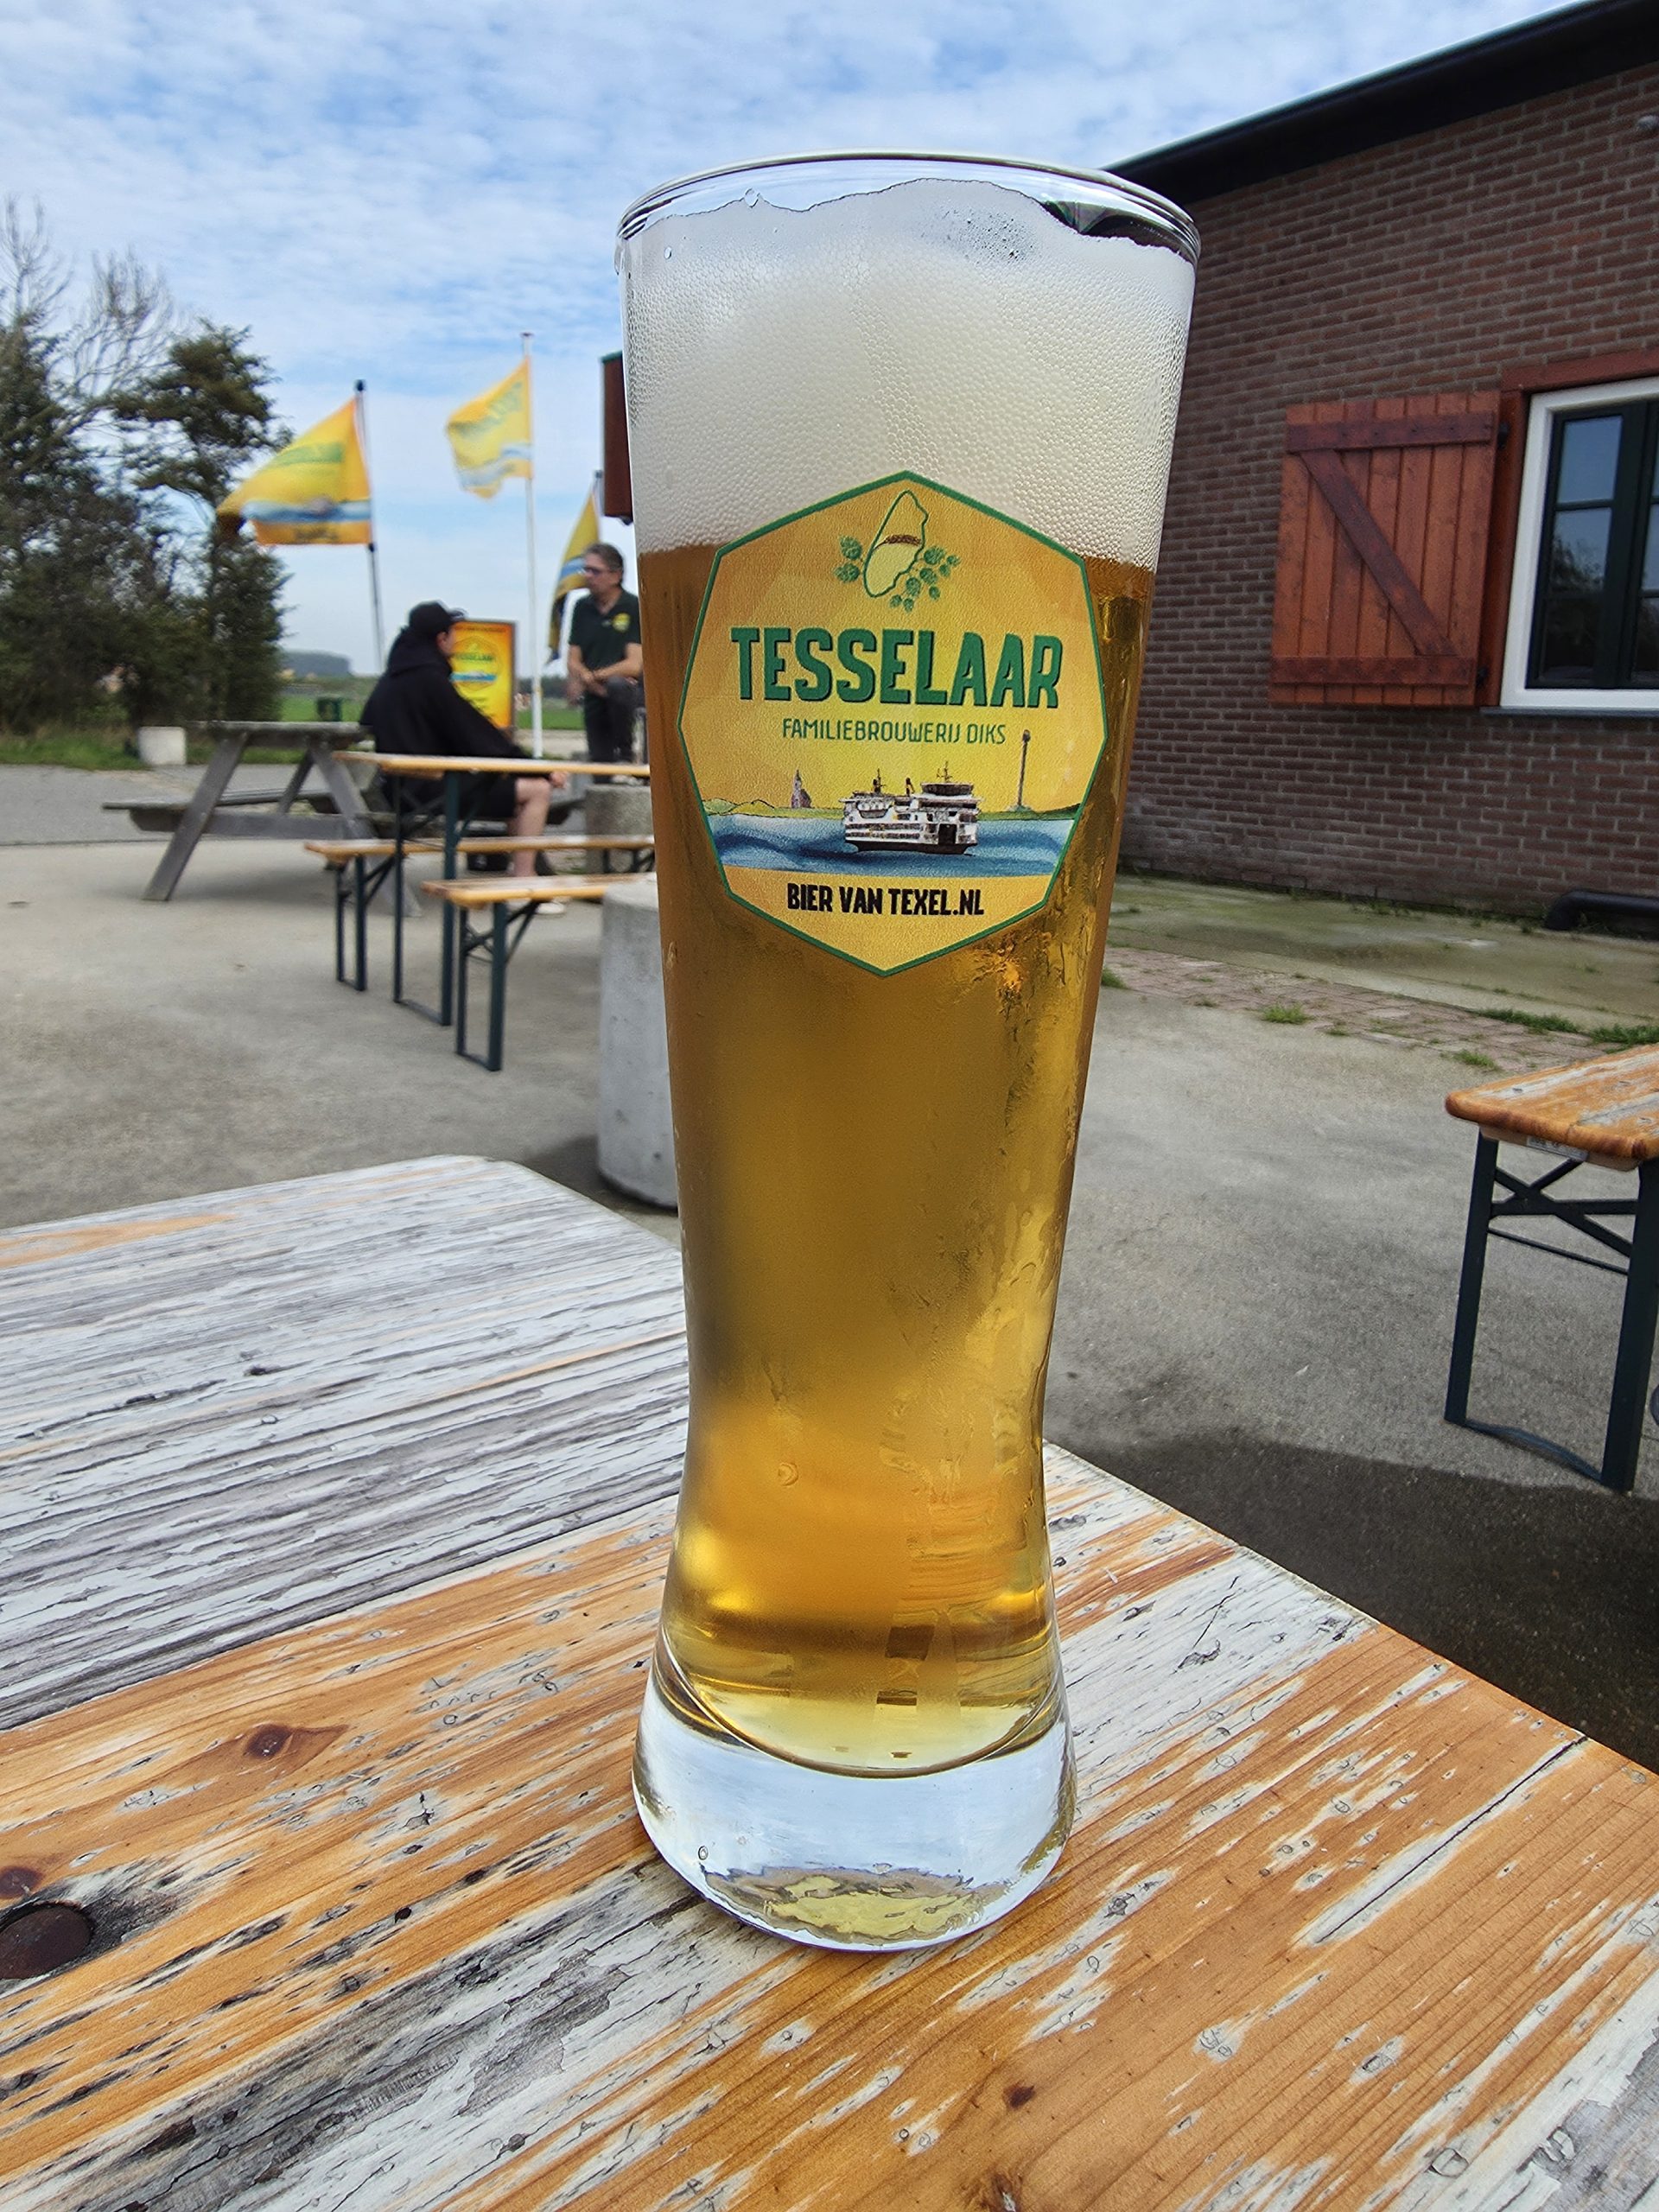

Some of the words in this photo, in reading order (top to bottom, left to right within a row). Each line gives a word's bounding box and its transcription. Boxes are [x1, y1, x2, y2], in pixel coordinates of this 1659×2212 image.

[731, 626, 1063, 709] TESSELAAR
[782, 718, 961, 743] FAMILIEBROUWERIJ
[966, 724, 1006, 745] DIKS
[787, 882, 833, 912] BIER
[839, 886, 883, 914] VAN
[888, 888, 984, 916] TEXEL.NL
